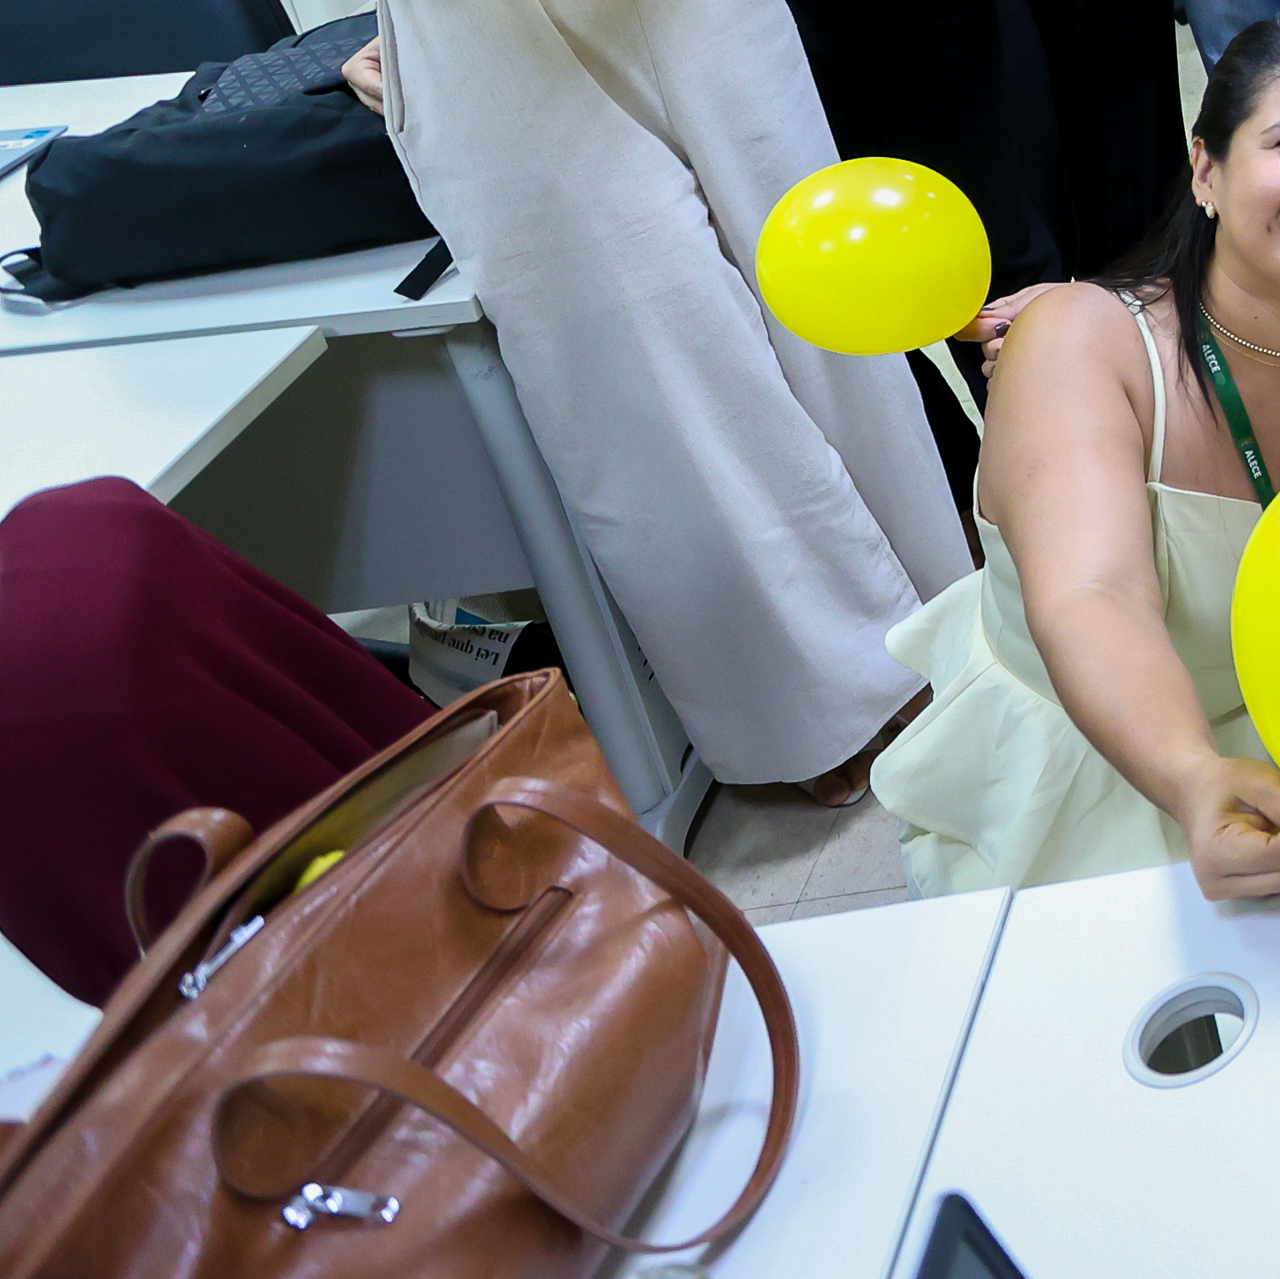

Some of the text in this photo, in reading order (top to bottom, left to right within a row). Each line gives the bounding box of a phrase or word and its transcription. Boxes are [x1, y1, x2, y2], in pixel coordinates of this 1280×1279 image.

[1201, 344, 1221, 374] ALECE
[1244, 450, 1262, 480] ALECE
[488, 628, 510, 644] na
[448, 637, 500, 666] Lei que
